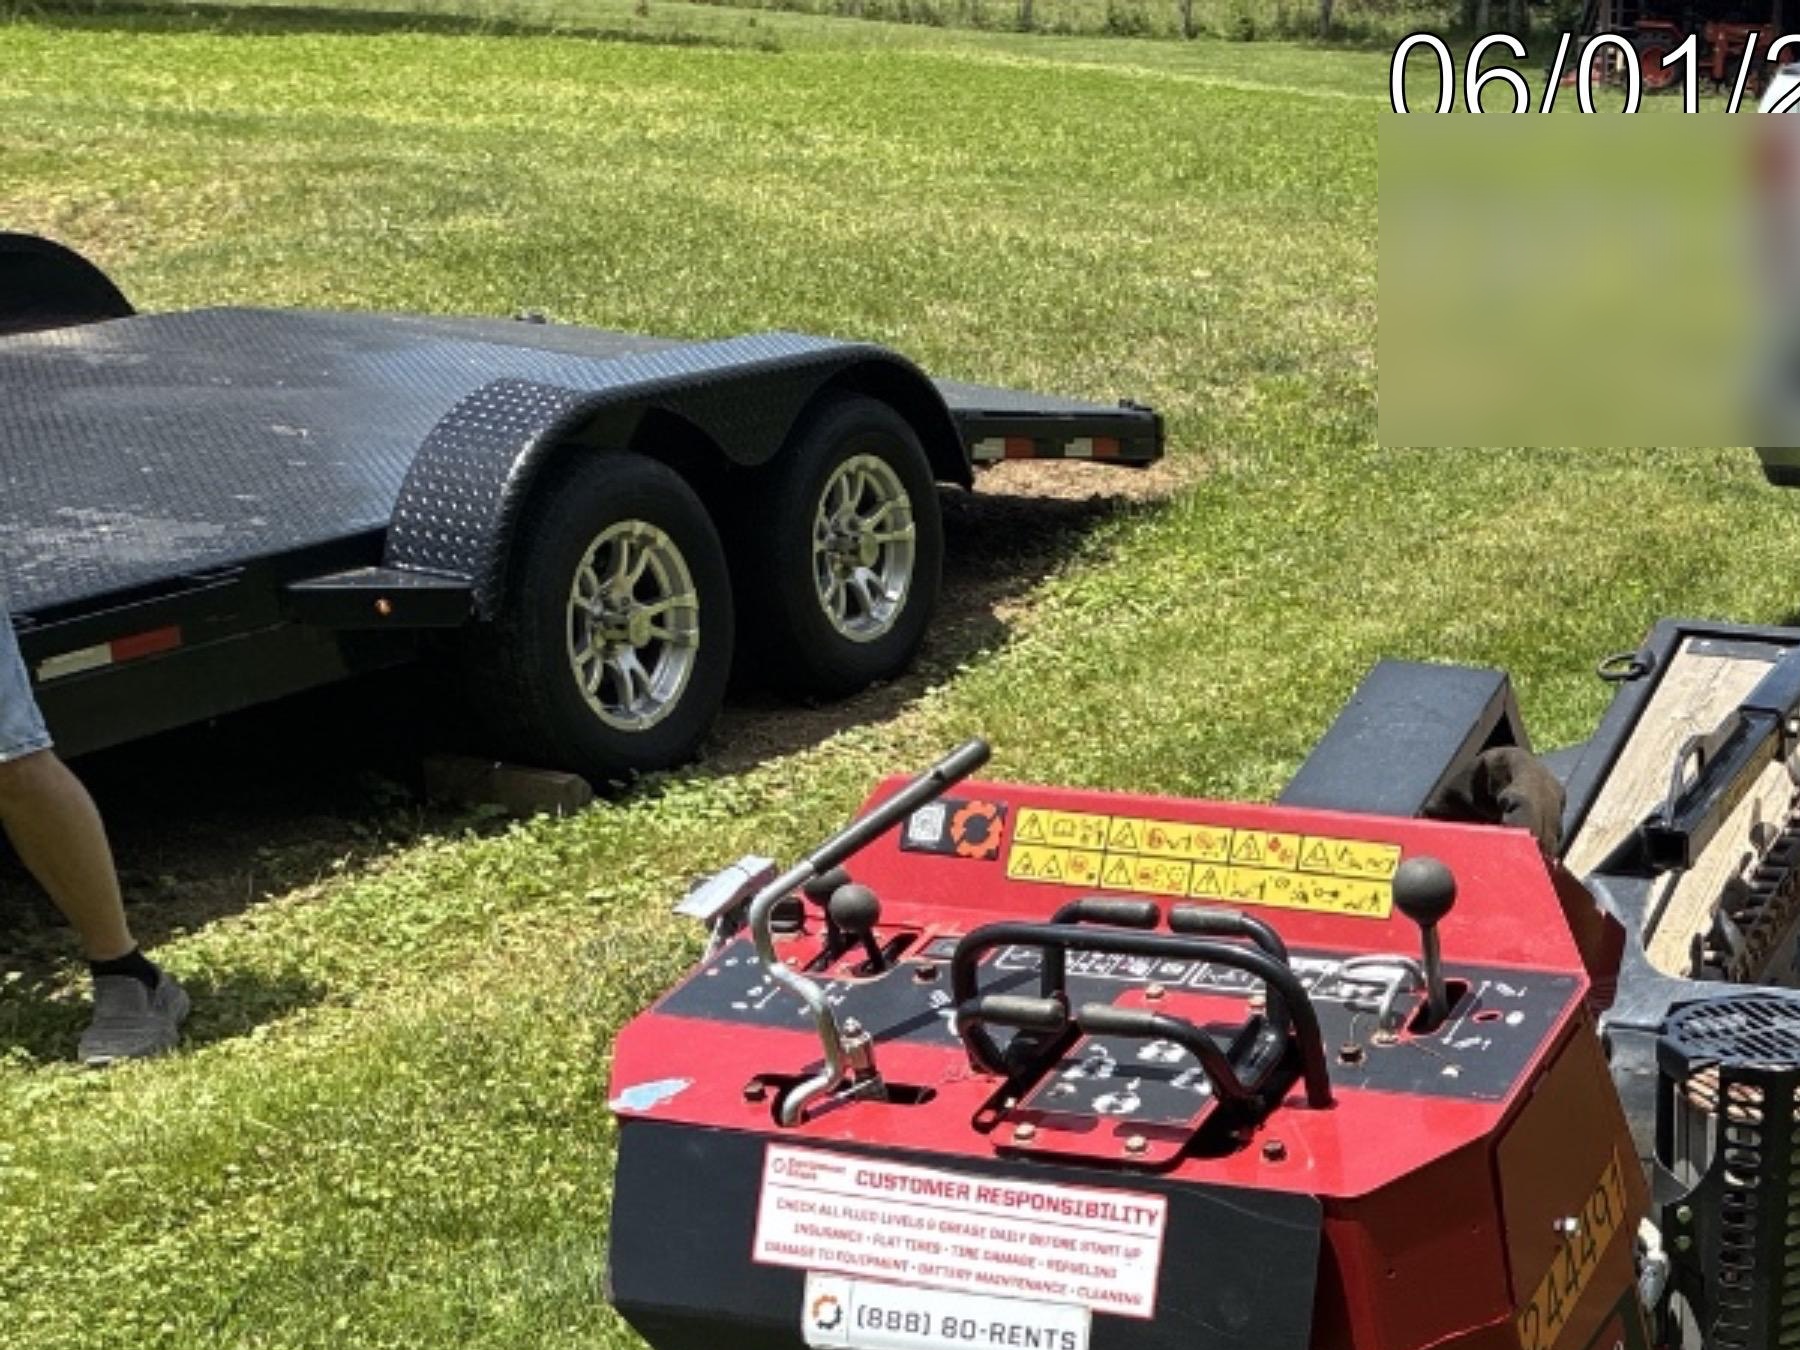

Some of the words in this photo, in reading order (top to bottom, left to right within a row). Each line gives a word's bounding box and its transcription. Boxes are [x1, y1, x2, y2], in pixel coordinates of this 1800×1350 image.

[817, 1201, 839, 1219] ALL
[855, 1169, 970, 1201] CUSTOMER
[977, 1184, 1159, 1227] RESPONSIBILITY
[855, 1304, 932, 1337] (888)
